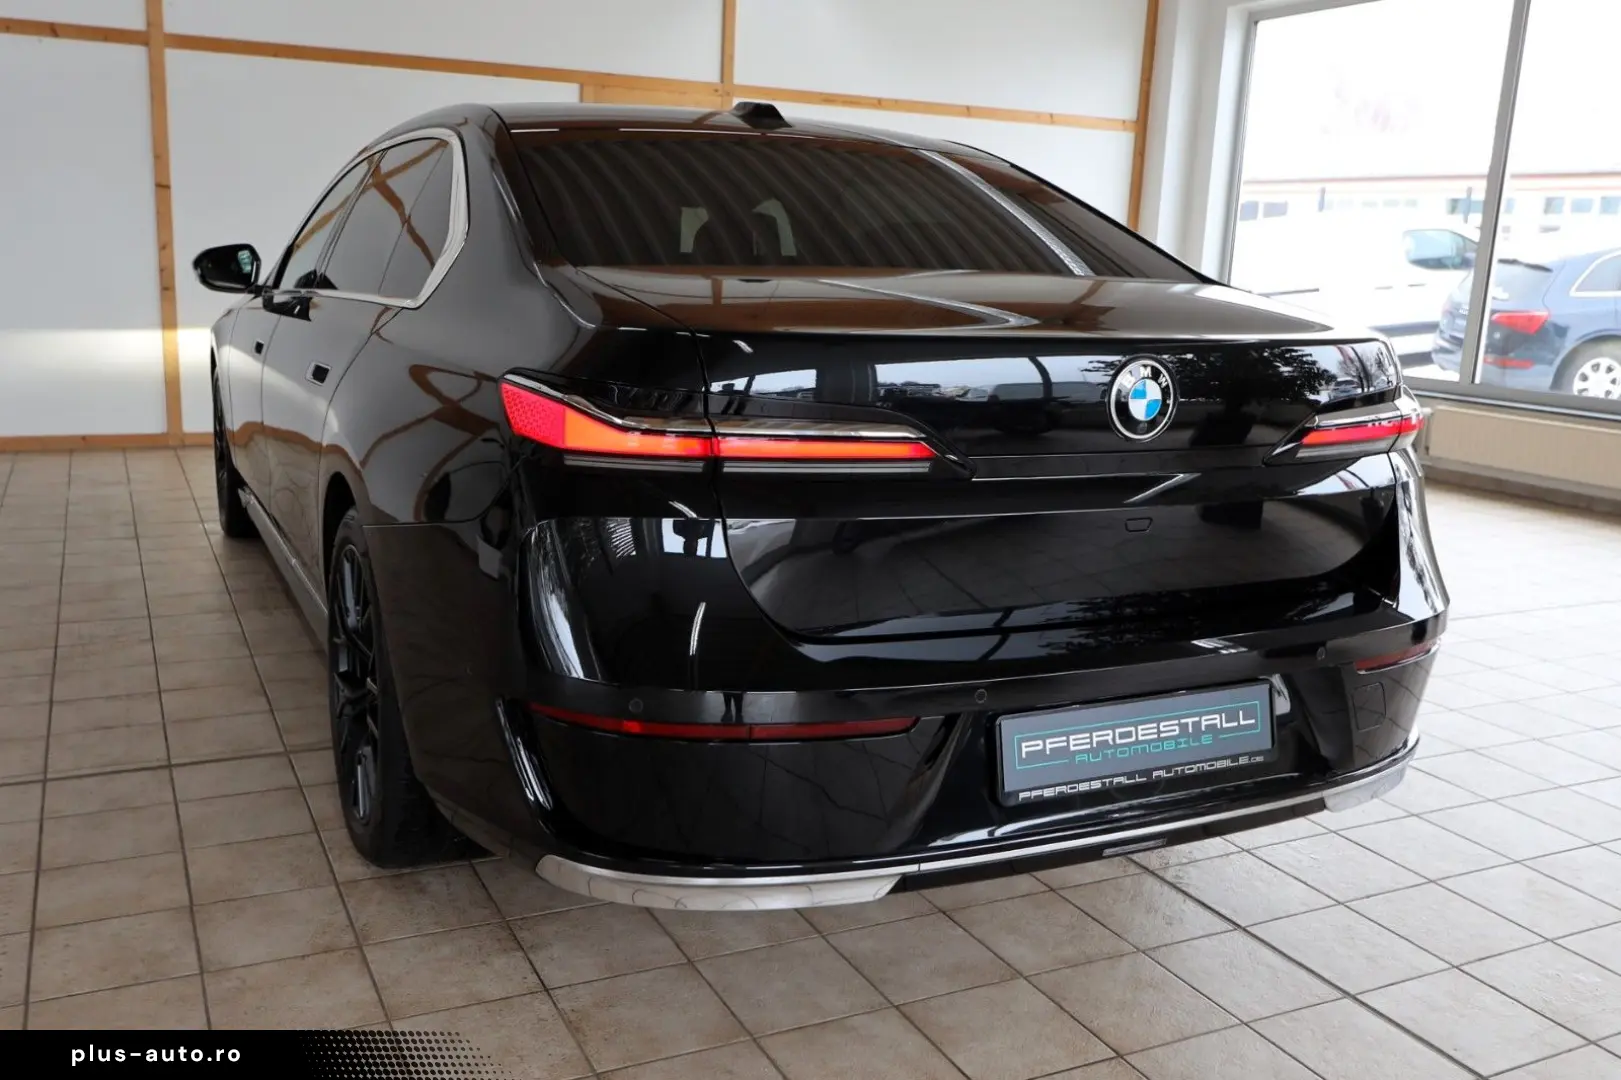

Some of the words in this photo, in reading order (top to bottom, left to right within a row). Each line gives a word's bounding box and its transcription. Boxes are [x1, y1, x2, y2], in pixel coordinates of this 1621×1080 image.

[1120, 365, 1168, 389] BMW
[1021, 710, 1256, 759] PFERDESTALL
[1075, 734, 1213, 765] AUTOMOBILE
[1018, 773, 1147, 801] PFERDESTALL
